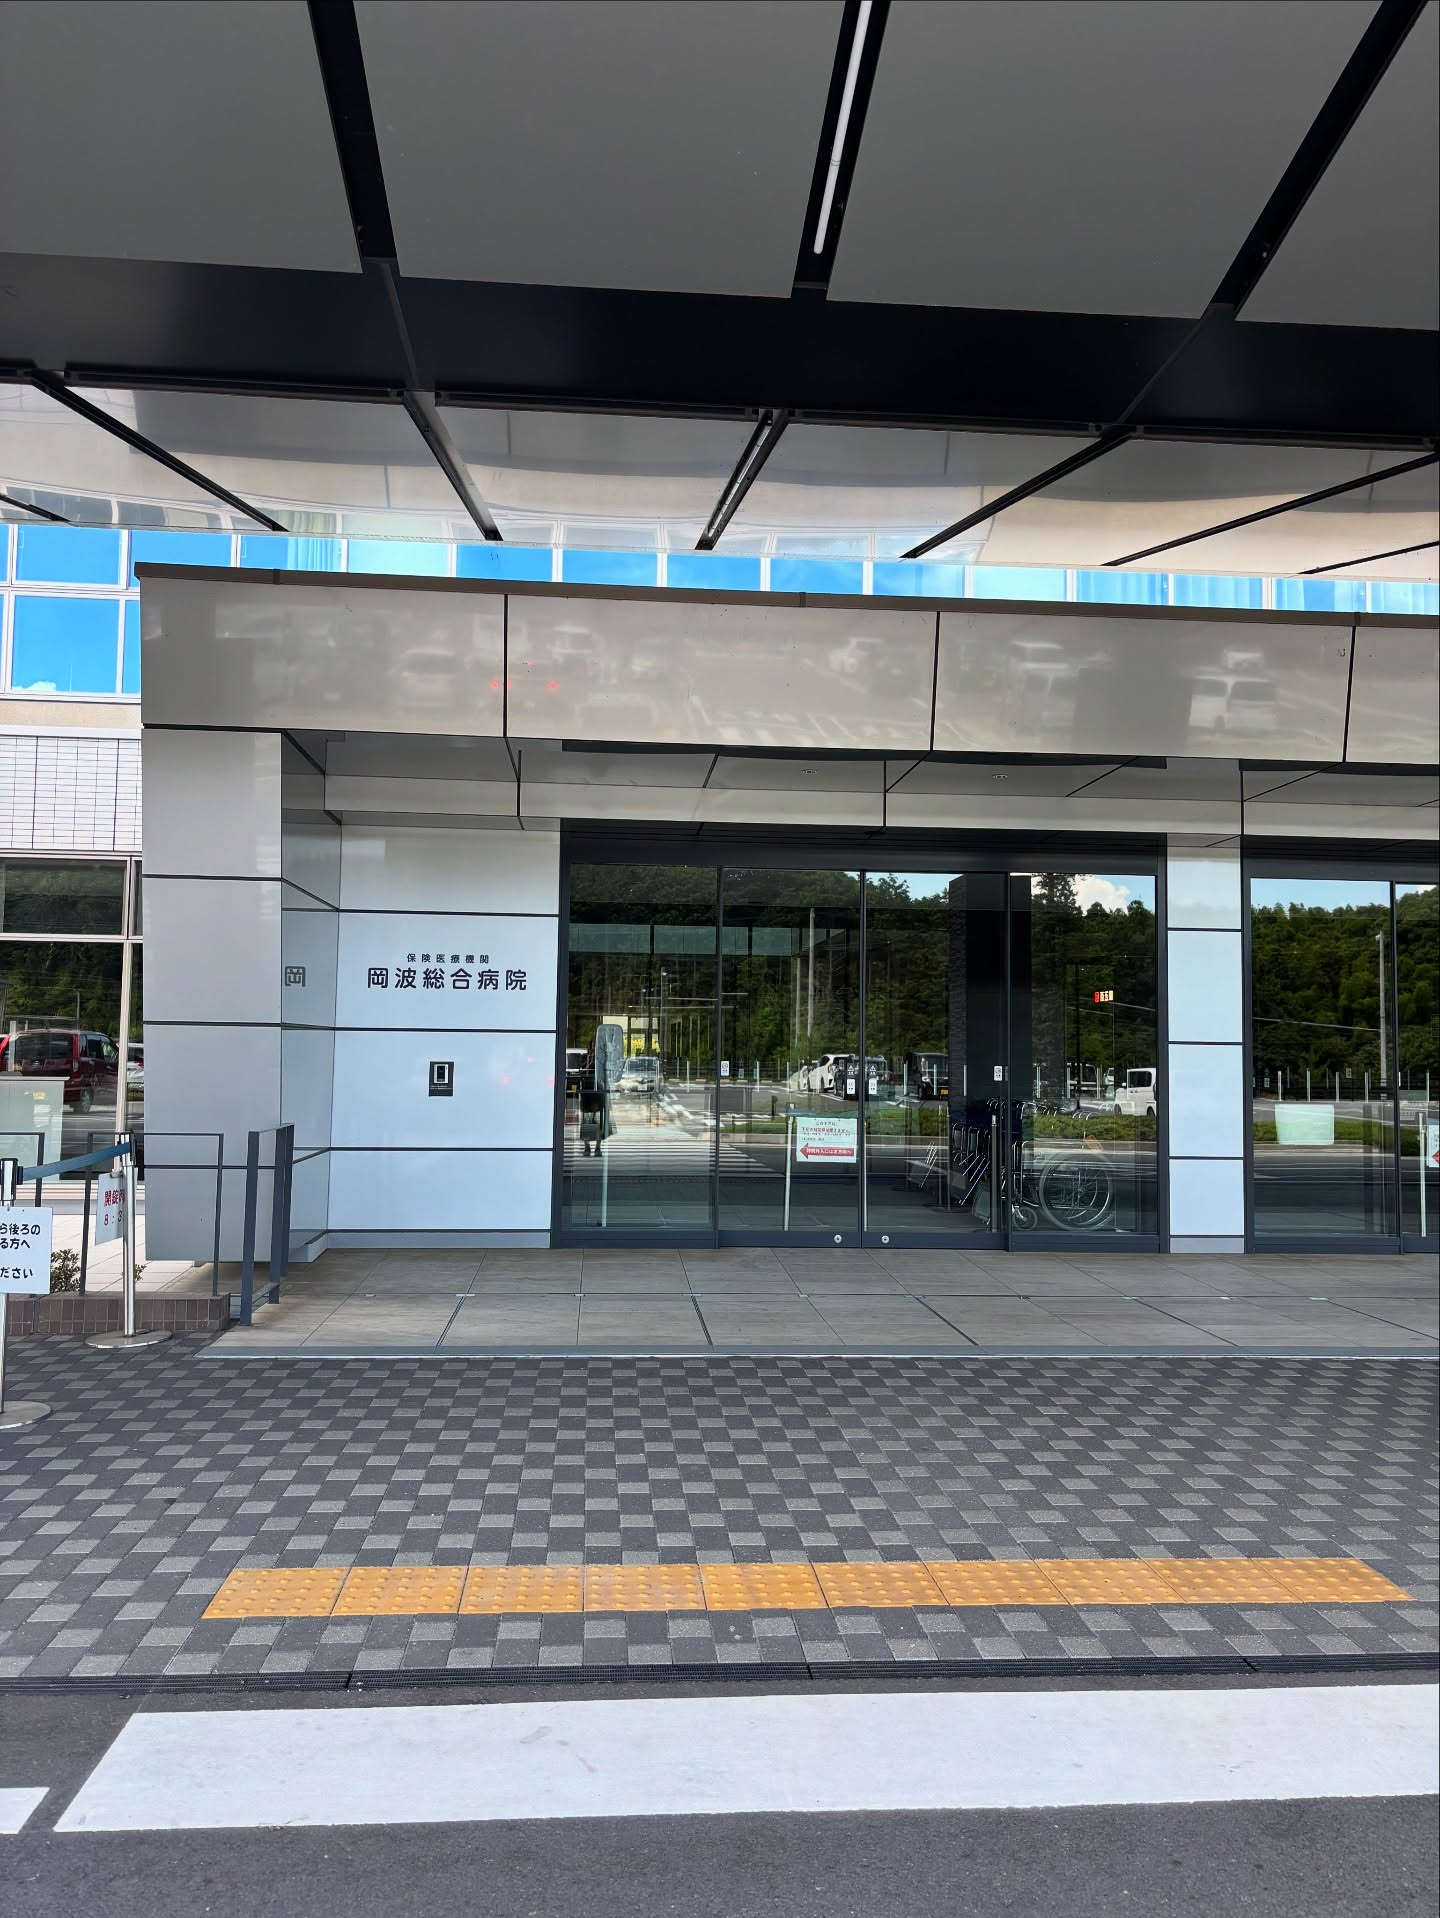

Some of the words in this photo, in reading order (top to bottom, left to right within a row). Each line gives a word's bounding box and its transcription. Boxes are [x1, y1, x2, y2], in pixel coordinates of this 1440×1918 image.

[406, 953, 489, 963] 保険医療機関
[367, 967, 527, 991] 岡波総合病院
